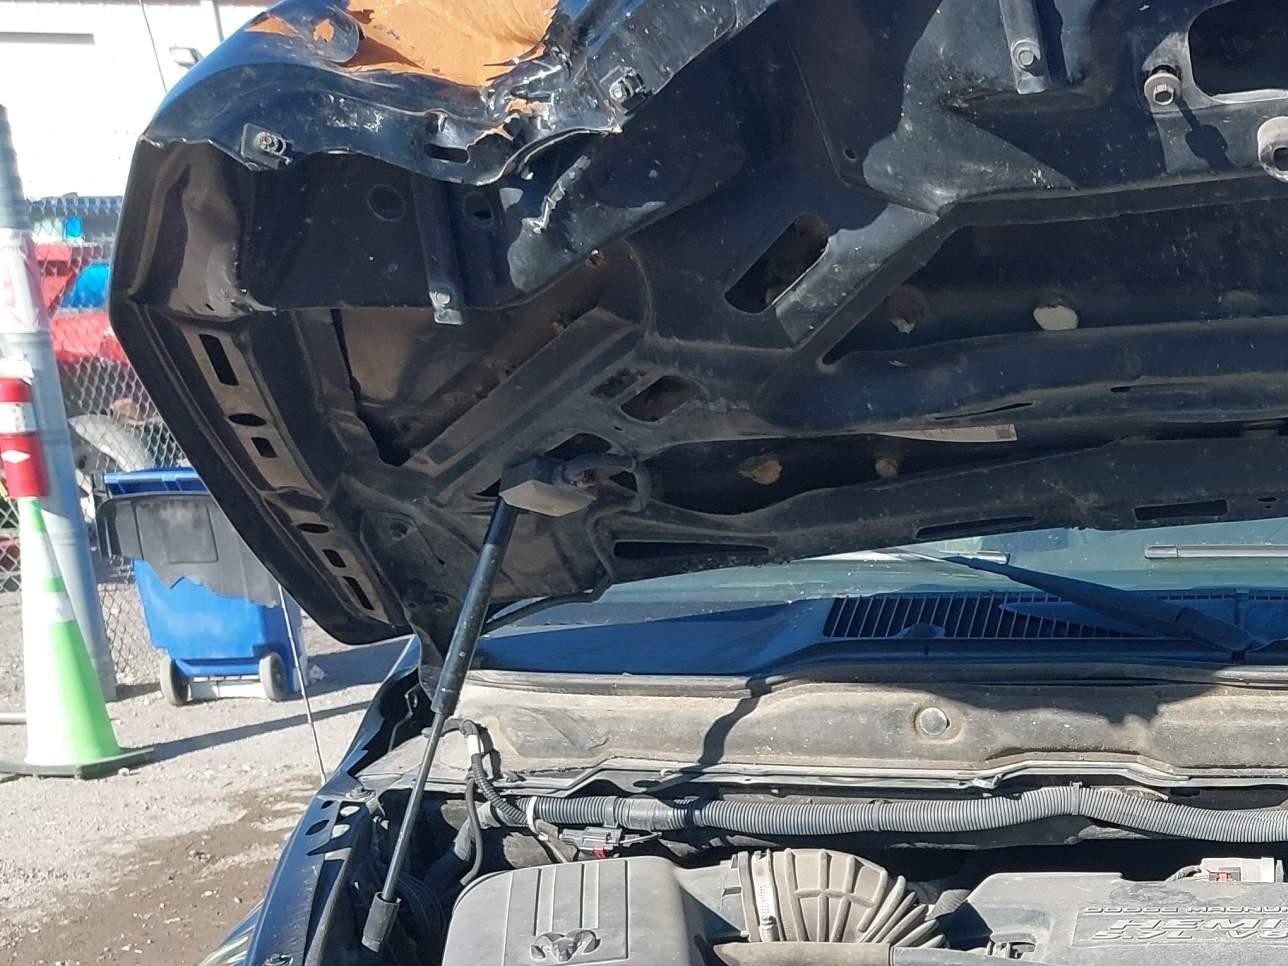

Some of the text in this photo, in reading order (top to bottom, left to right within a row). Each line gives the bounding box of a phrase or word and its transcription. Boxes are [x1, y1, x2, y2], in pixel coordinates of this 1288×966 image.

[1083, 906, 1179, 914] DODGE
[1108, 918, 1286, 930] HEMI
[1090, 930, 1194, 940] 5.7L
